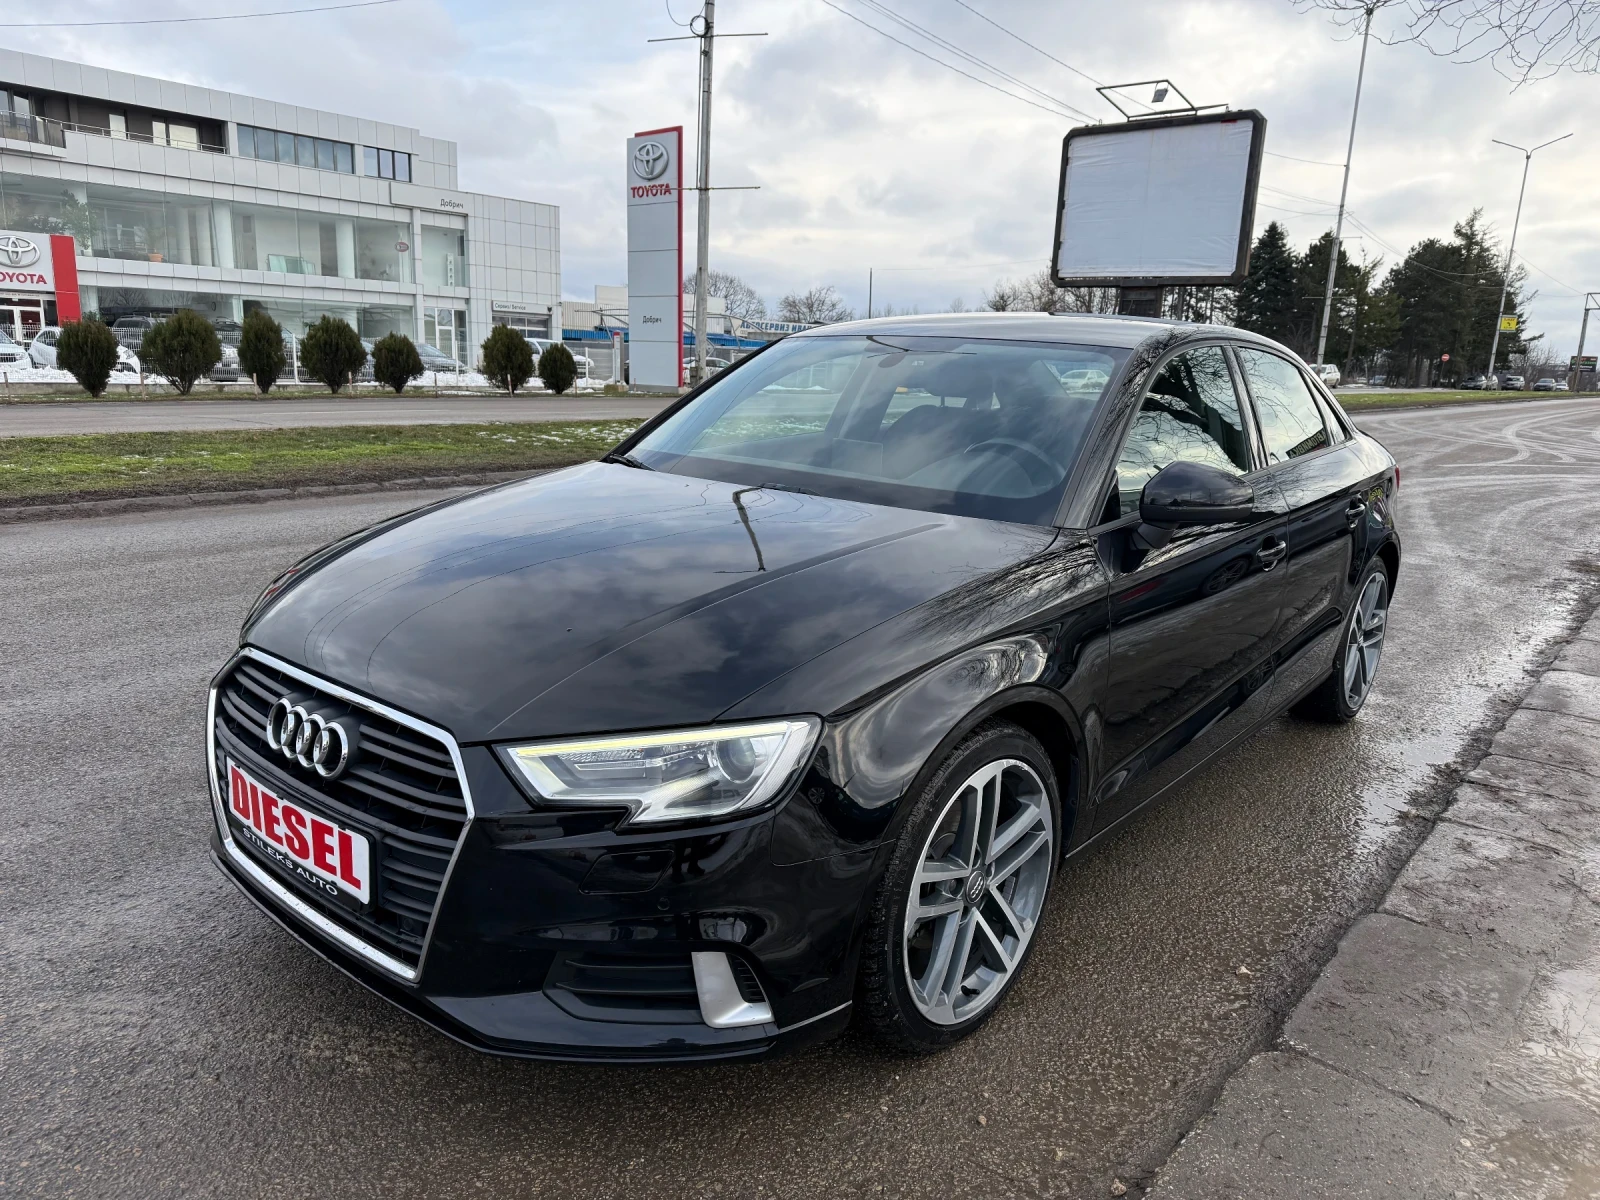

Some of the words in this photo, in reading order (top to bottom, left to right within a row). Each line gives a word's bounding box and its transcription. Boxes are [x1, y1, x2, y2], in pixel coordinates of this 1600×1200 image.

[631, 183, 672, 199] TOYOTA
[440, 198, 464, 209] Добрич
[0, 271, 48, 285] OYOTA
[642, 315, 662, 325] Добрич
[230, 764, 362, 891] DIESEL
[242, 827, 294, 869] STILEKS
[296, 867, 338, 896] AUTO
